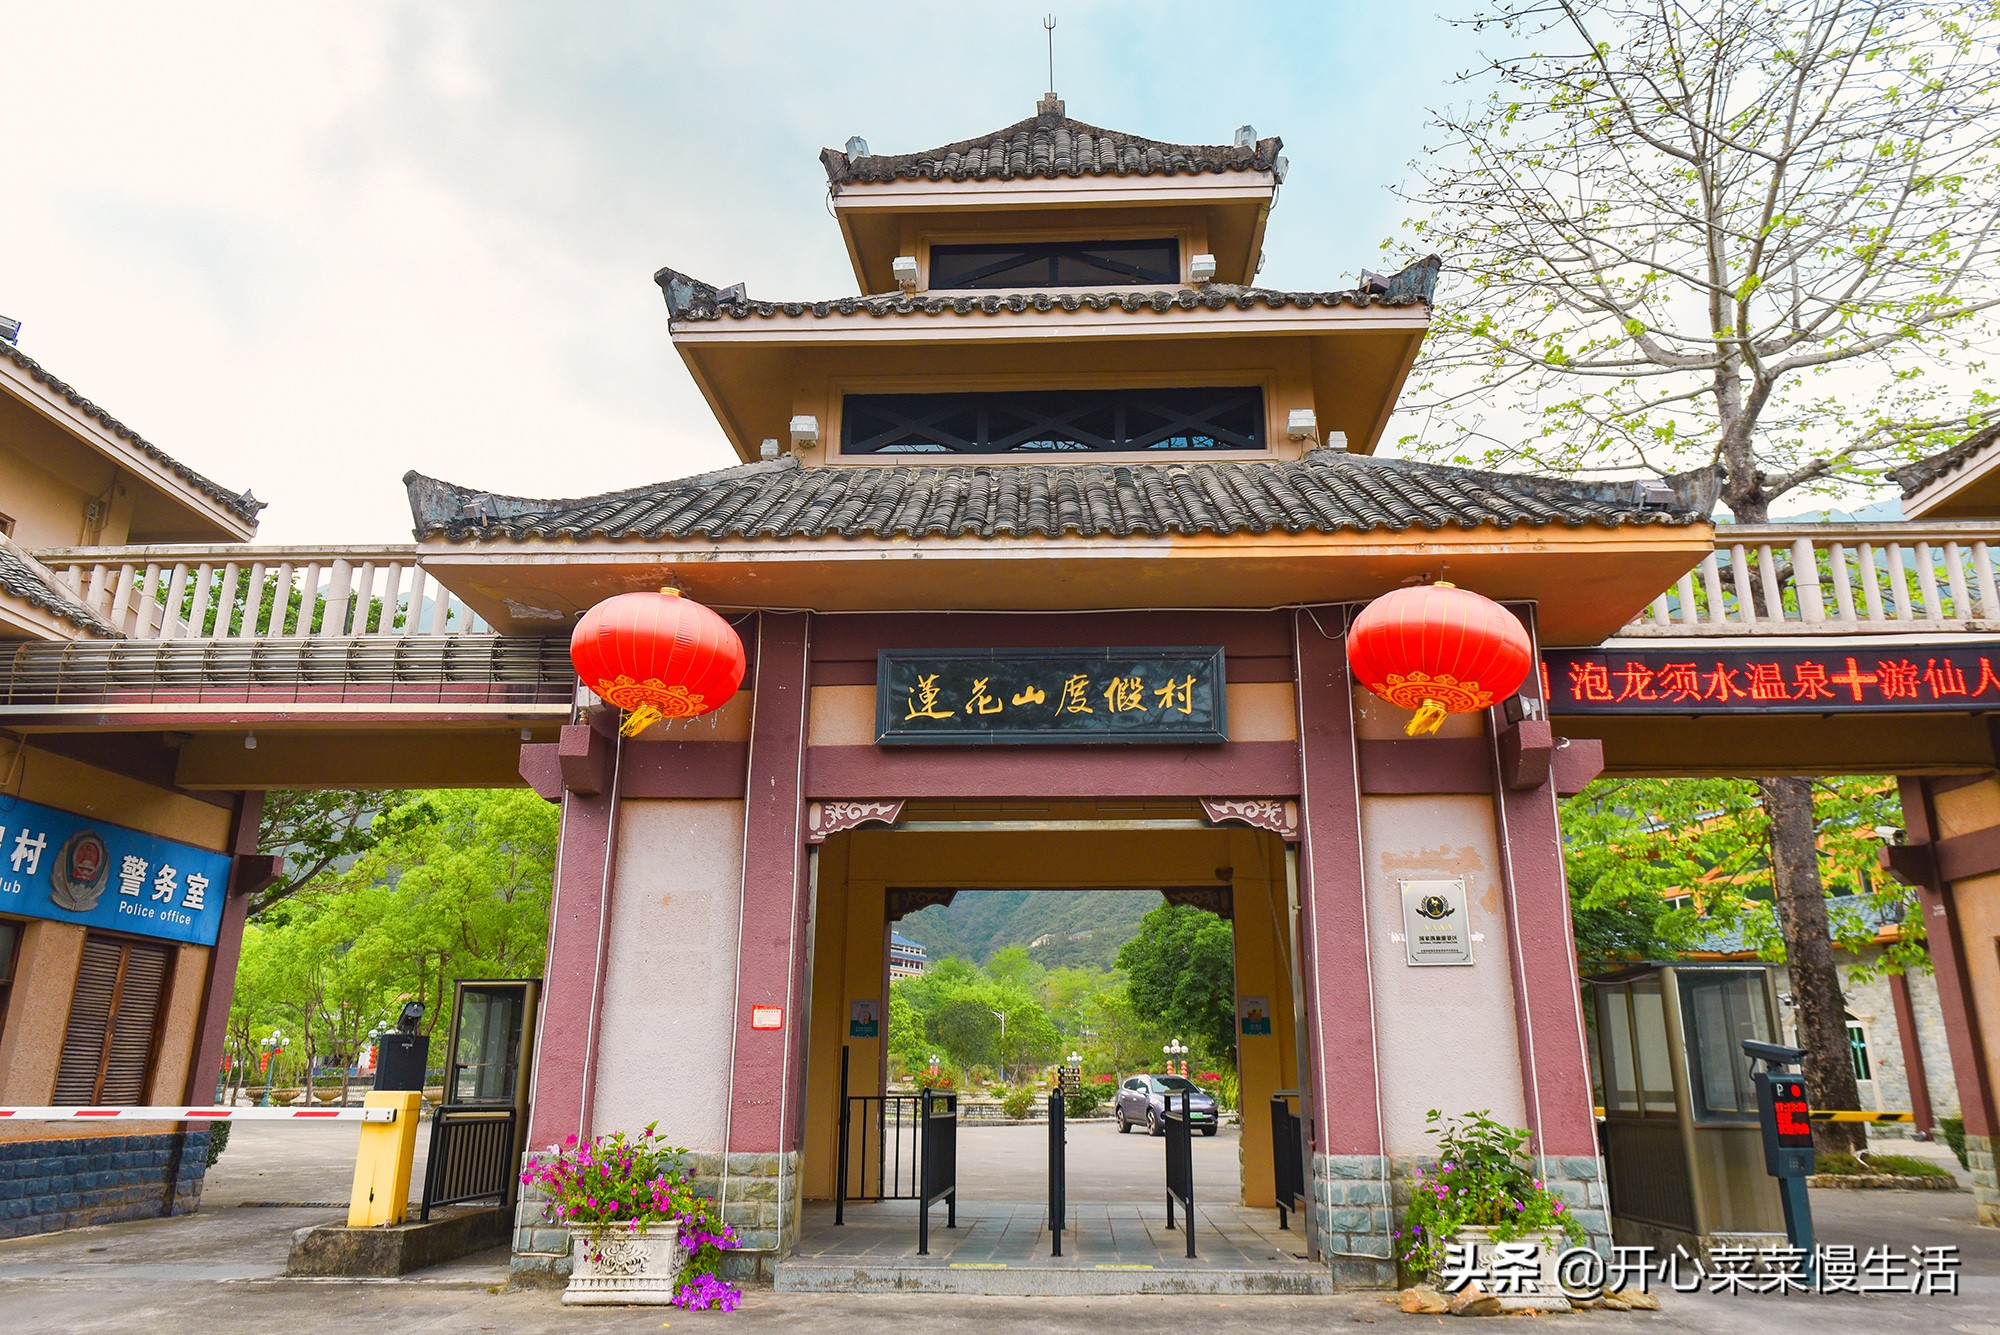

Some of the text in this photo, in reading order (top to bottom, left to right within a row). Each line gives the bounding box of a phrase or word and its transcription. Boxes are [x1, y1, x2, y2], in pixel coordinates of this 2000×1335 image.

[904, 673, 1197, 721] 蓮花山度假村
[0, 826, 47, 875] 村
[119, 854, 209, 910] 警务室
[118, 901, 192, 926] Police office
